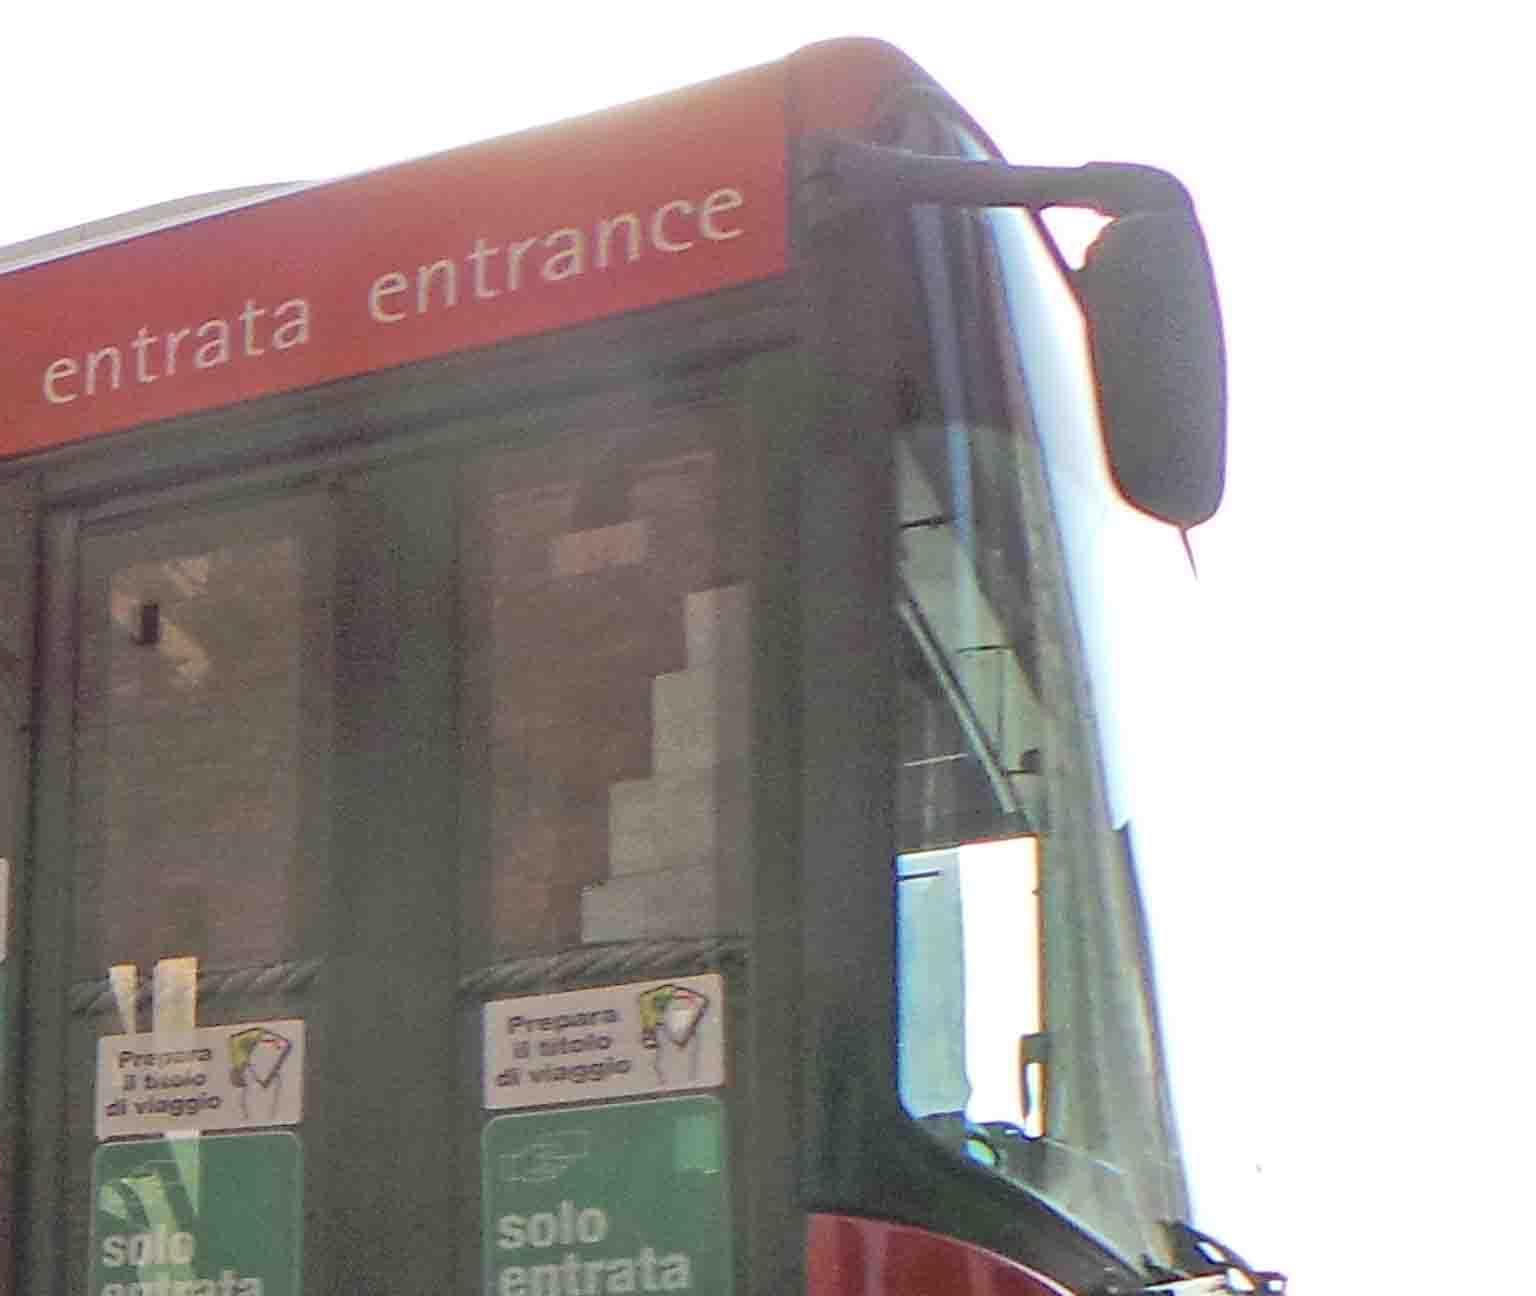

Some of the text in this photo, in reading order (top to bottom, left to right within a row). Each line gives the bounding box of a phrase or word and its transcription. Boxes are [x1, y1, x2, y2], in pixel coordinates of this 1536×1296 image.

[41, 186, 745, 405] entrata entrance
[508, 1008, 620, 1035] Prepara
[102, 1226, 195, 1268] solo
[496, 1199, 609, 1249] solo
